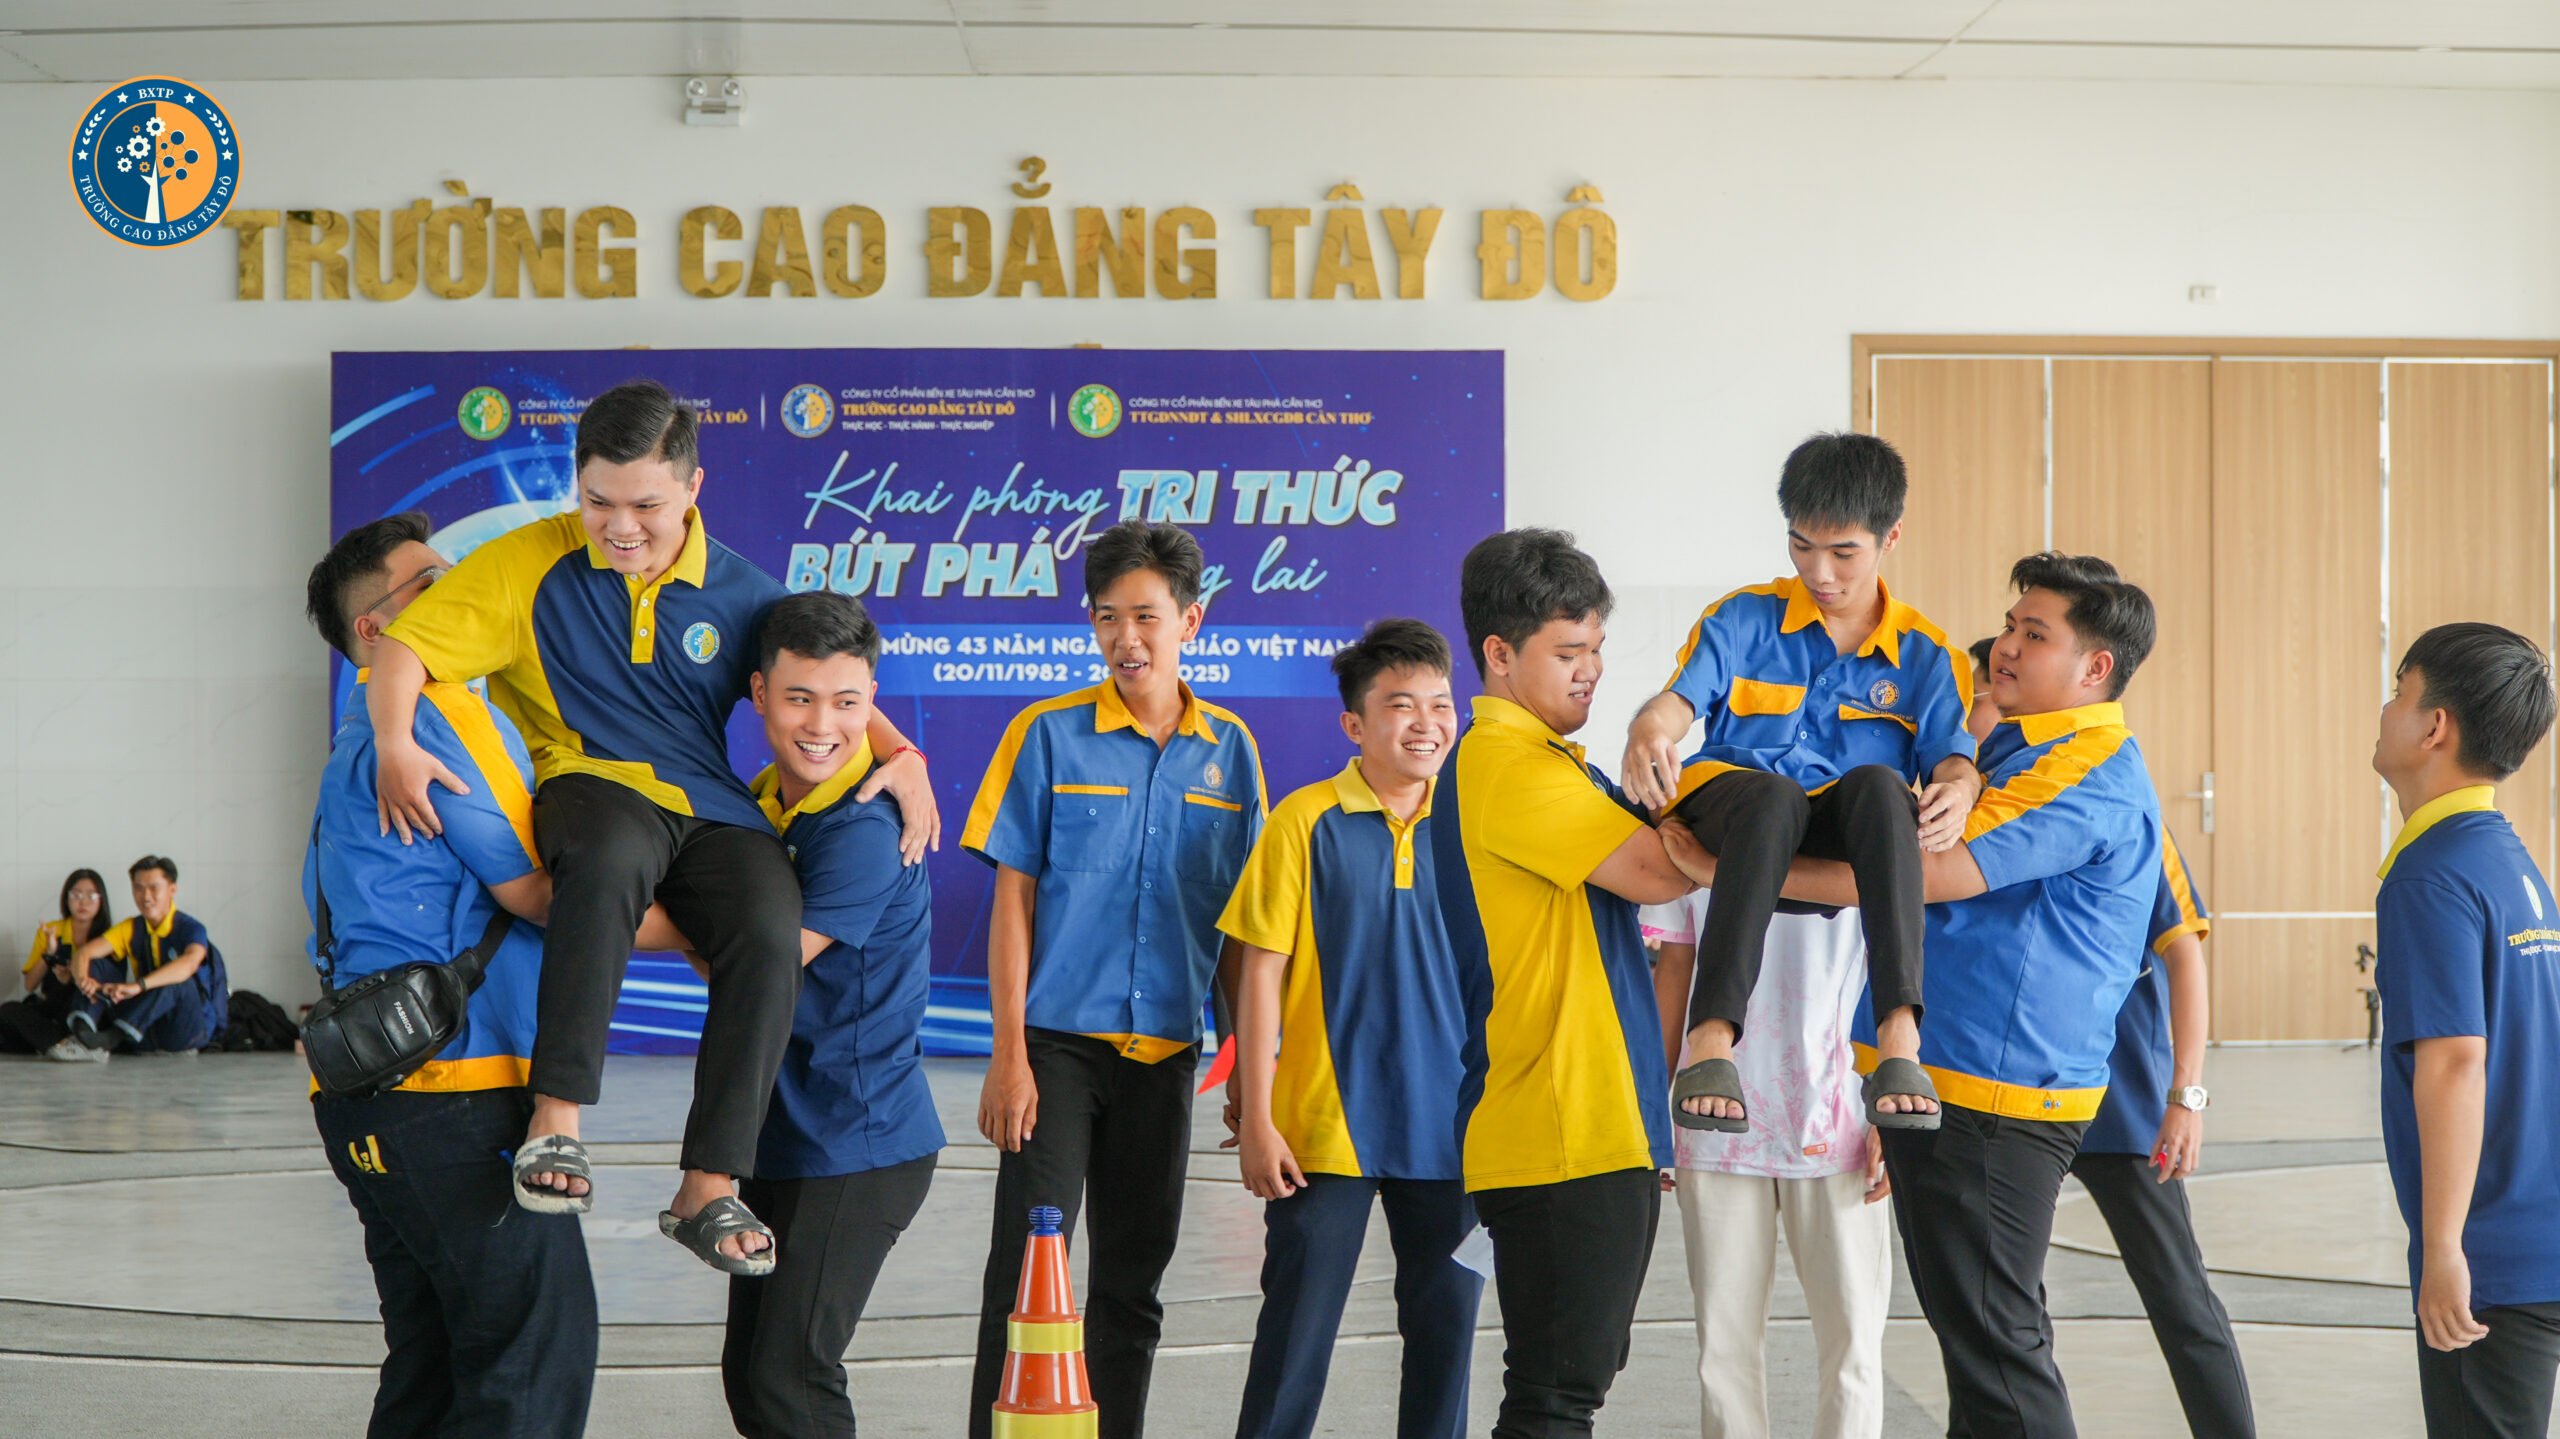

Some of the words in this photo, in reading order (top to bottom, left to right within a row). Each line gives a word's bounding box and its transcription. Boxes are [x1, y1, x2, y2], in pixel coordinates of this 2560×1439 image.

[222, 178, 637, 301] TRƯỜNG
[678, 204, 888, 300] CAO
[923, 156, 1216, 300] ĐẲNG
[1253, 183, 1443, 300] TÂY
[1476, 184, 1617, 300] ĐÔ
[841, 387, 871, 399] CÔNG
[872, 388, 882, 399] TY
[883, 385, 899, 399] CỔ
[1128, 397, 1159, 408] CÔNG
[1160, 398, 1170, 408] TY
[1170, 395, 1187, 409] CỔ
[518, 398, 548, 410] CÔNG
[841, 401, 898, 416] TRƯỜNG
[899, 403, 927, 416] CAO
[967, 400, 993, 416] TÂY
[1210, 412, 1223, 424] &
[1305, 409, 1337, 424] CẦN
[1339, 411, 1373, 425] THƠ
[804, 450, 953, 530] Khai
[952, 461, 1110, 560] phóng
[1116, 469, 1219, 524] TRI
[1232, 454, 1404, 526] THỨC
[785, 526, 916, 597] BỨT
[921, 526, 1059, 597] PHÁ
[1251, 535, 1328, 594] lai
[881, 632, 950, 655] MỪNG
[956, 637, 988, 655] 43
[993, 633, 1046, 655] NĂM
[1052, 632, 1103, 655] NGÀ
[1181, 633, 1241, 657] GIÁO
[1246, 633, 1298, 661] VIỆT
[933, 662, 1068, 683] (20/11/1982
[393, 1001, 415, 1035] FASHION
